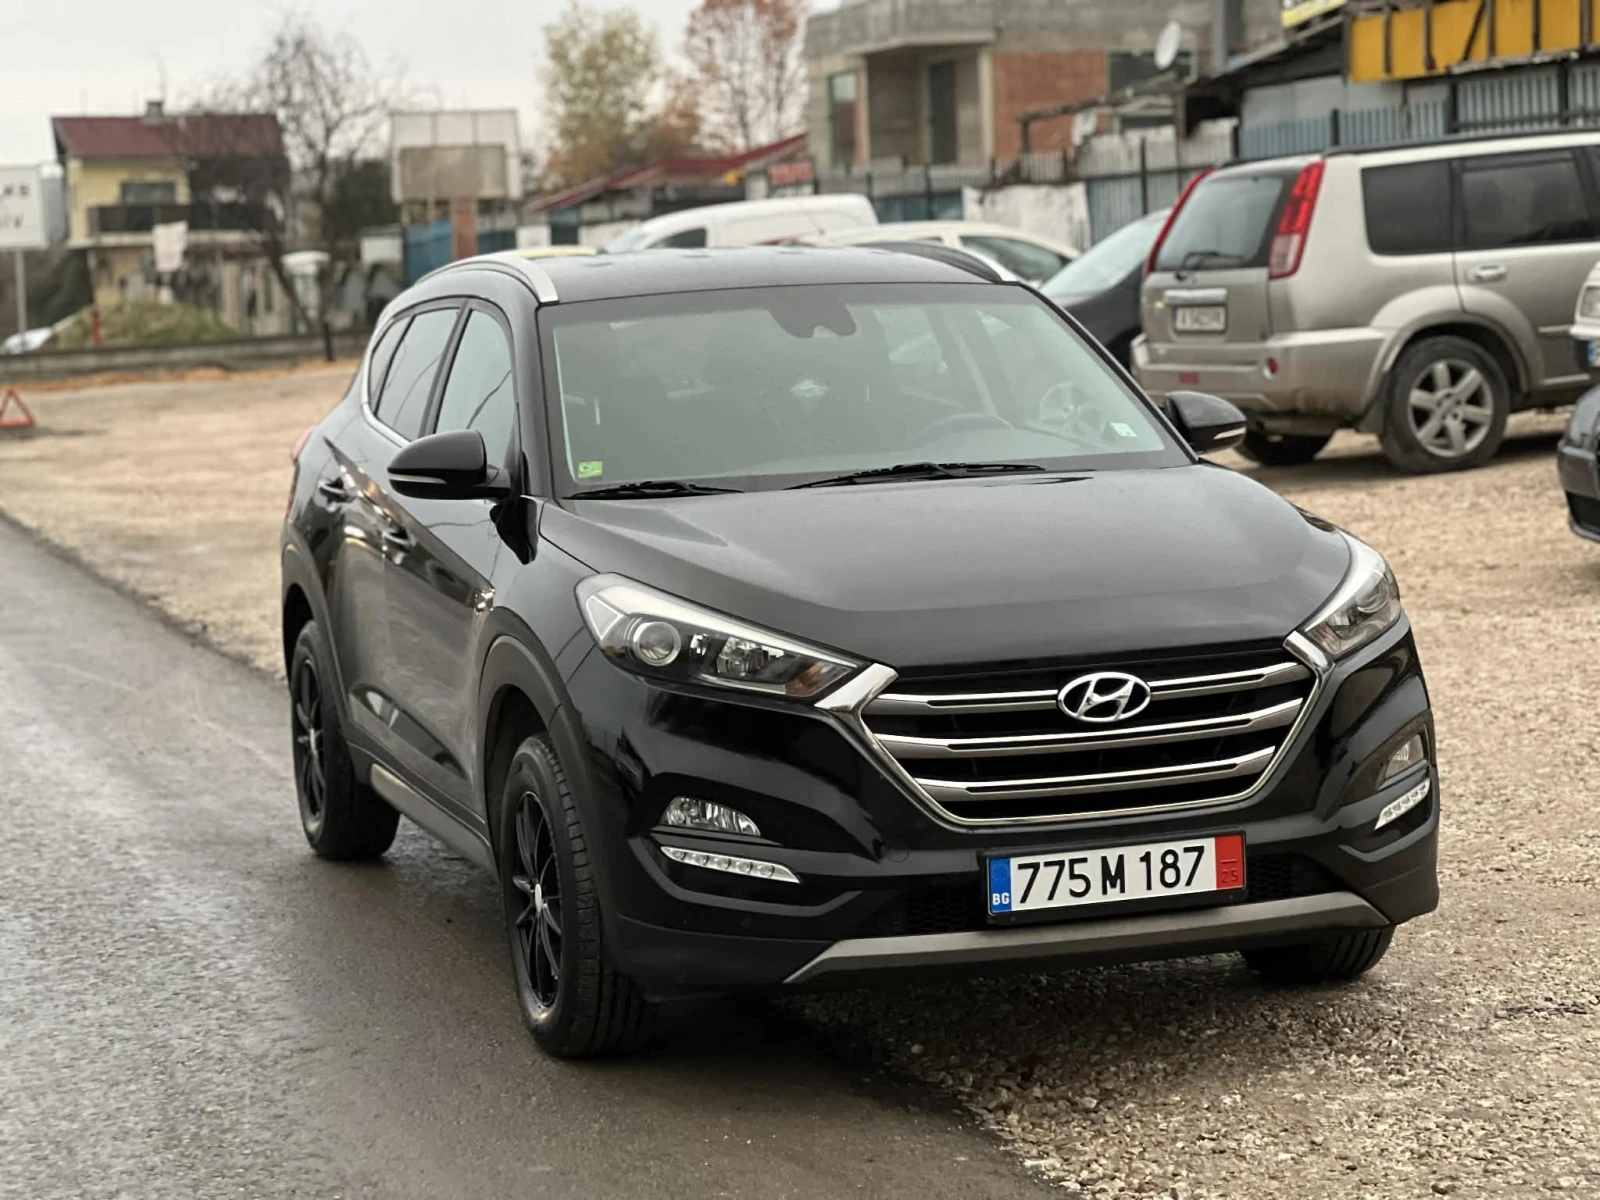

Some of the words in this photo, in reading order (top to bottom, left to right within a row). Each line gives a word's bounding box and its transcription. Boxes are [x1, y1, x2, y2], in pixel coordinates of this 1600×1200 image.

[1017, 857, 1092, 904] 775
[1101, 853, 1126, 895] M
[1139, 845, 1205, 891] 187
[992, 892, 1010, 906] BG
